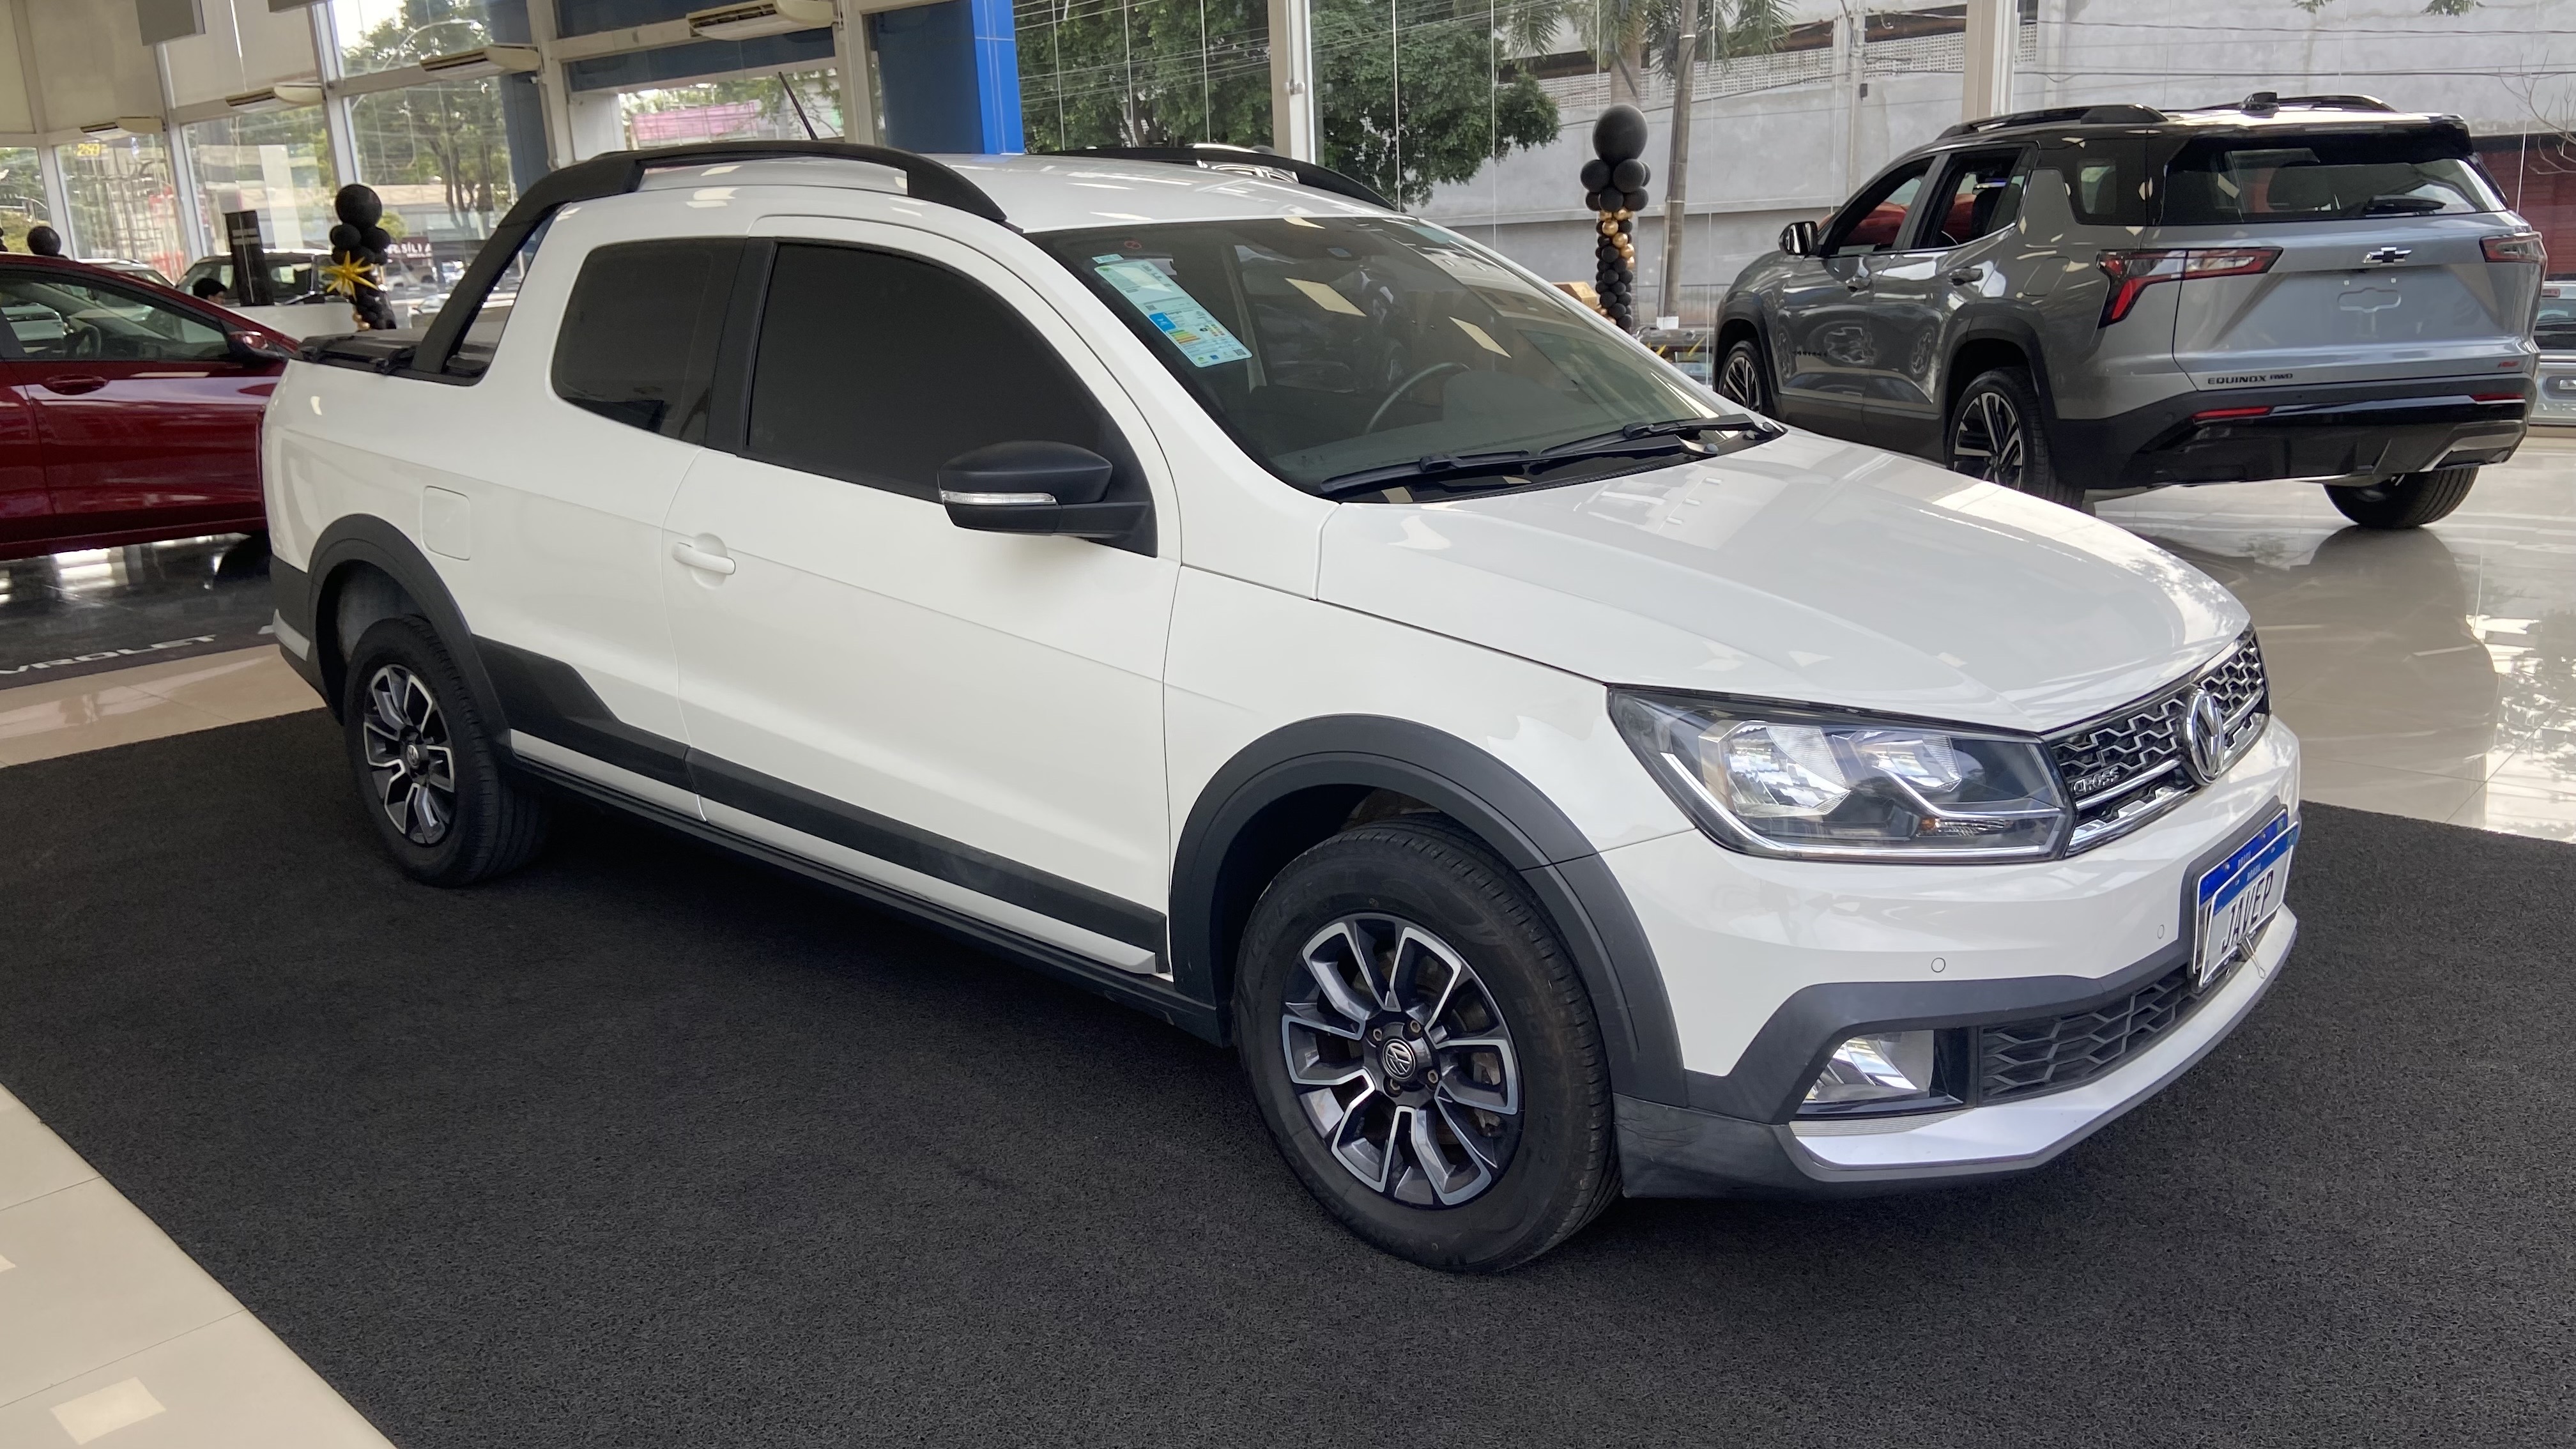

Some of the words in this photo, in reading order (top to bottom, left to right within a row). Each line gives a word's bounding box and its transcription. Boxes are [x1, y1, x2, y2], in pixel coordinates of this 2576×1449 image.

[2208, 375, 2266, 385] EQUINOX
[2073, 767, 2120, 795] CROSS
[2221, 868, 2274, 954] JAVEP
